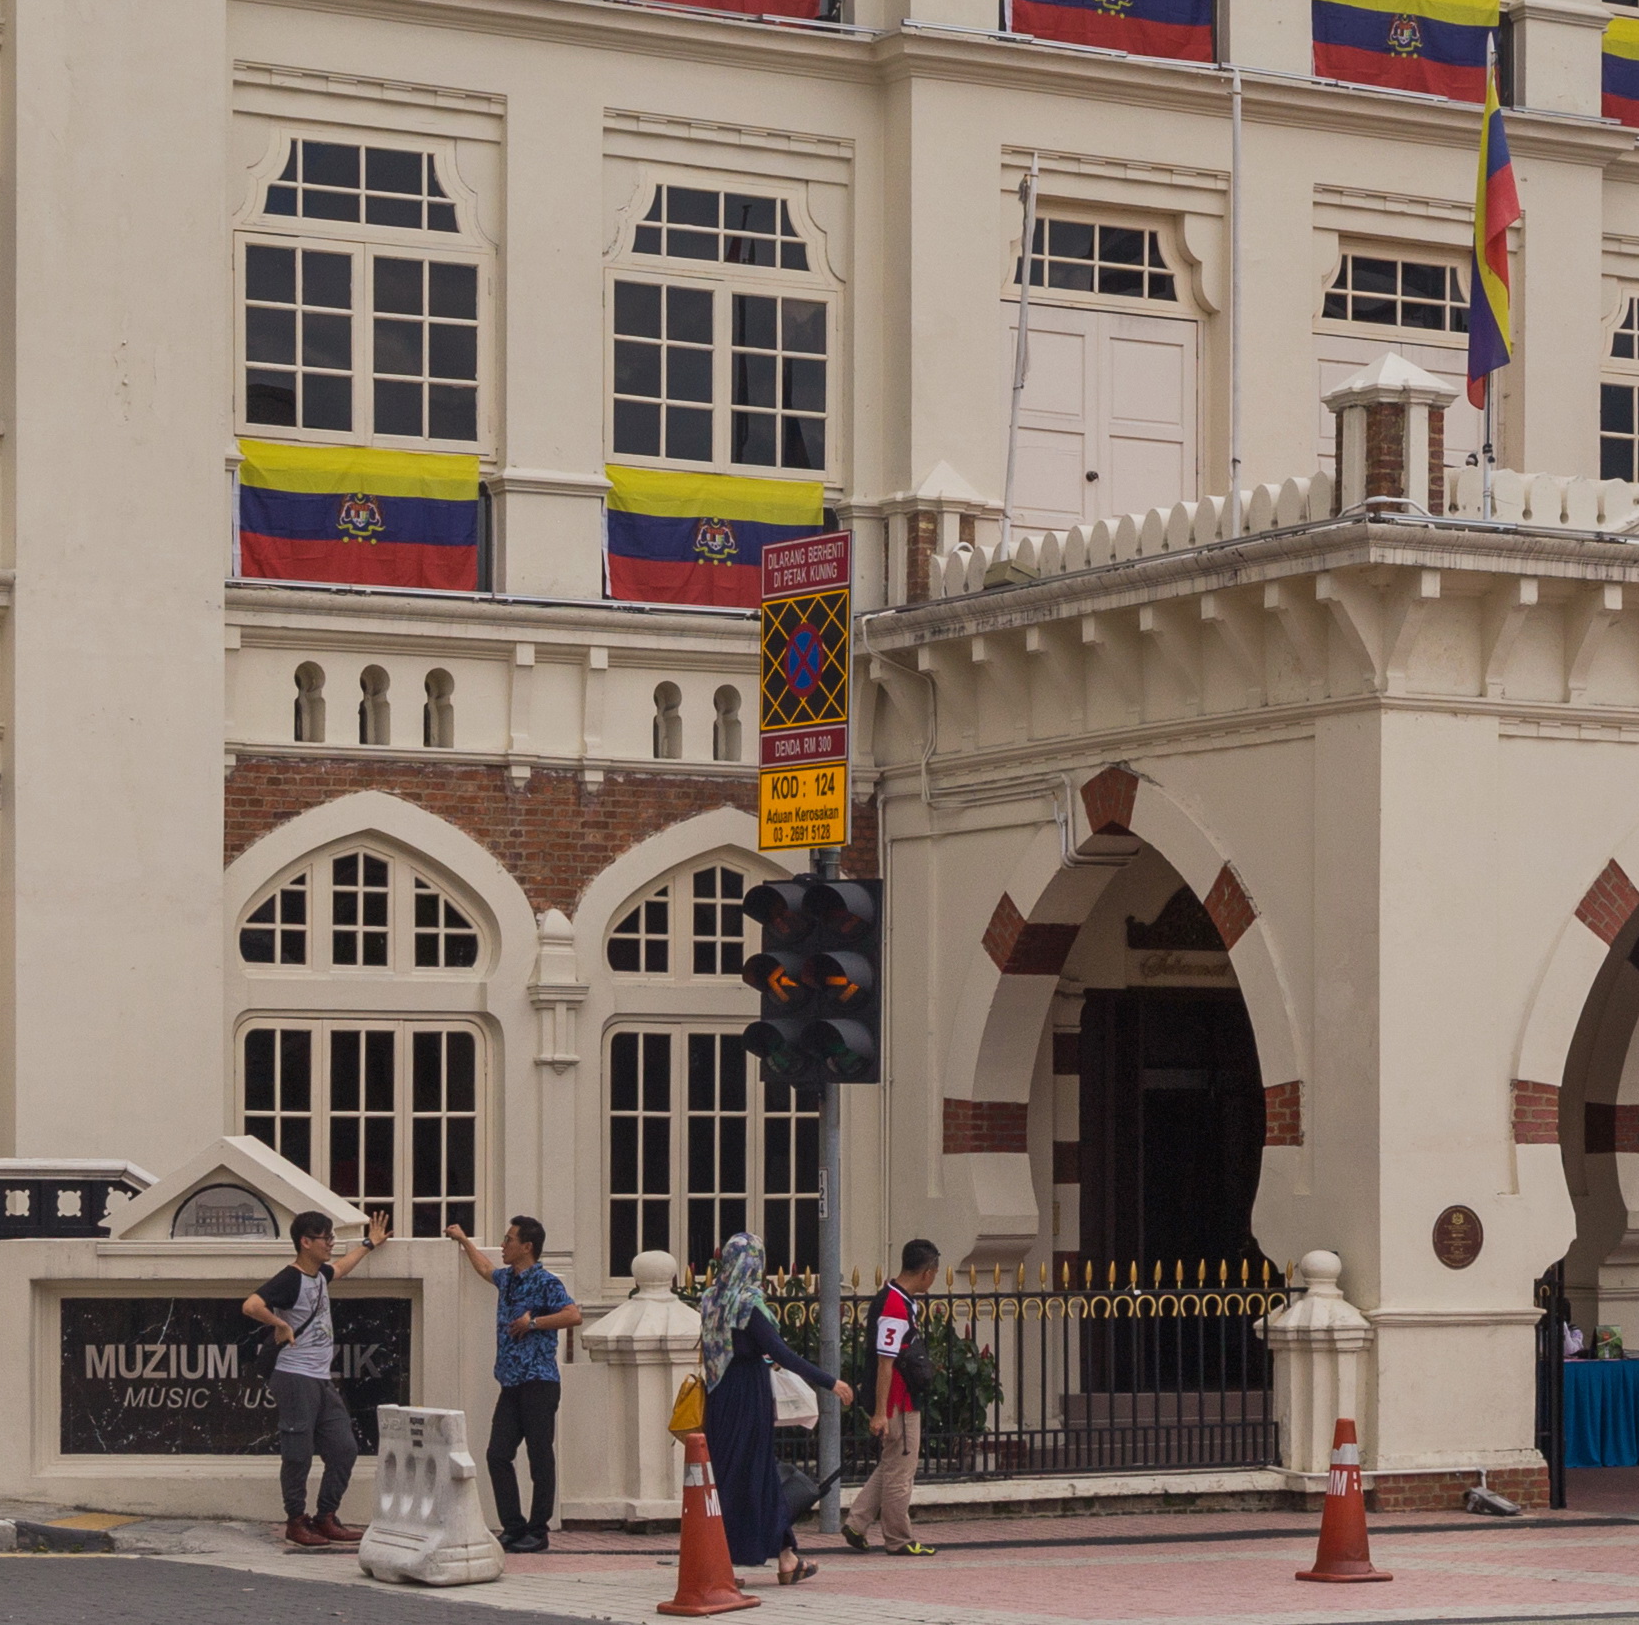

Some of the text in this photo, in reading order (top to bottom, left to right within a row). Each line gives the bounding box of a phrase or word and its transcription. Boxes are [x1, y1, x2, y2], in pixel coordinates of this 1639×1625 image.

[767, 542, 844, 570] DILARANG BERHENTI
[773, 562, 838, 588] DI PETAK KUNING
[774, 735, 832, 757] DENDA RM 300
[771, 775, 799, 800] KOD
[814, 772, 835, 797] 124
[766, 805, 839, 825] Aduan Kerosakan
[773, 826, 784, 843] 03
[790, 825, 809, 842] 2691
[811, 824, 831, 841] 5128
[884, 1328, 897, 1346] 3
[85, 1343, 239, 1379] MUZIUM
[124, 1386, 211, 1409] MUSIC
